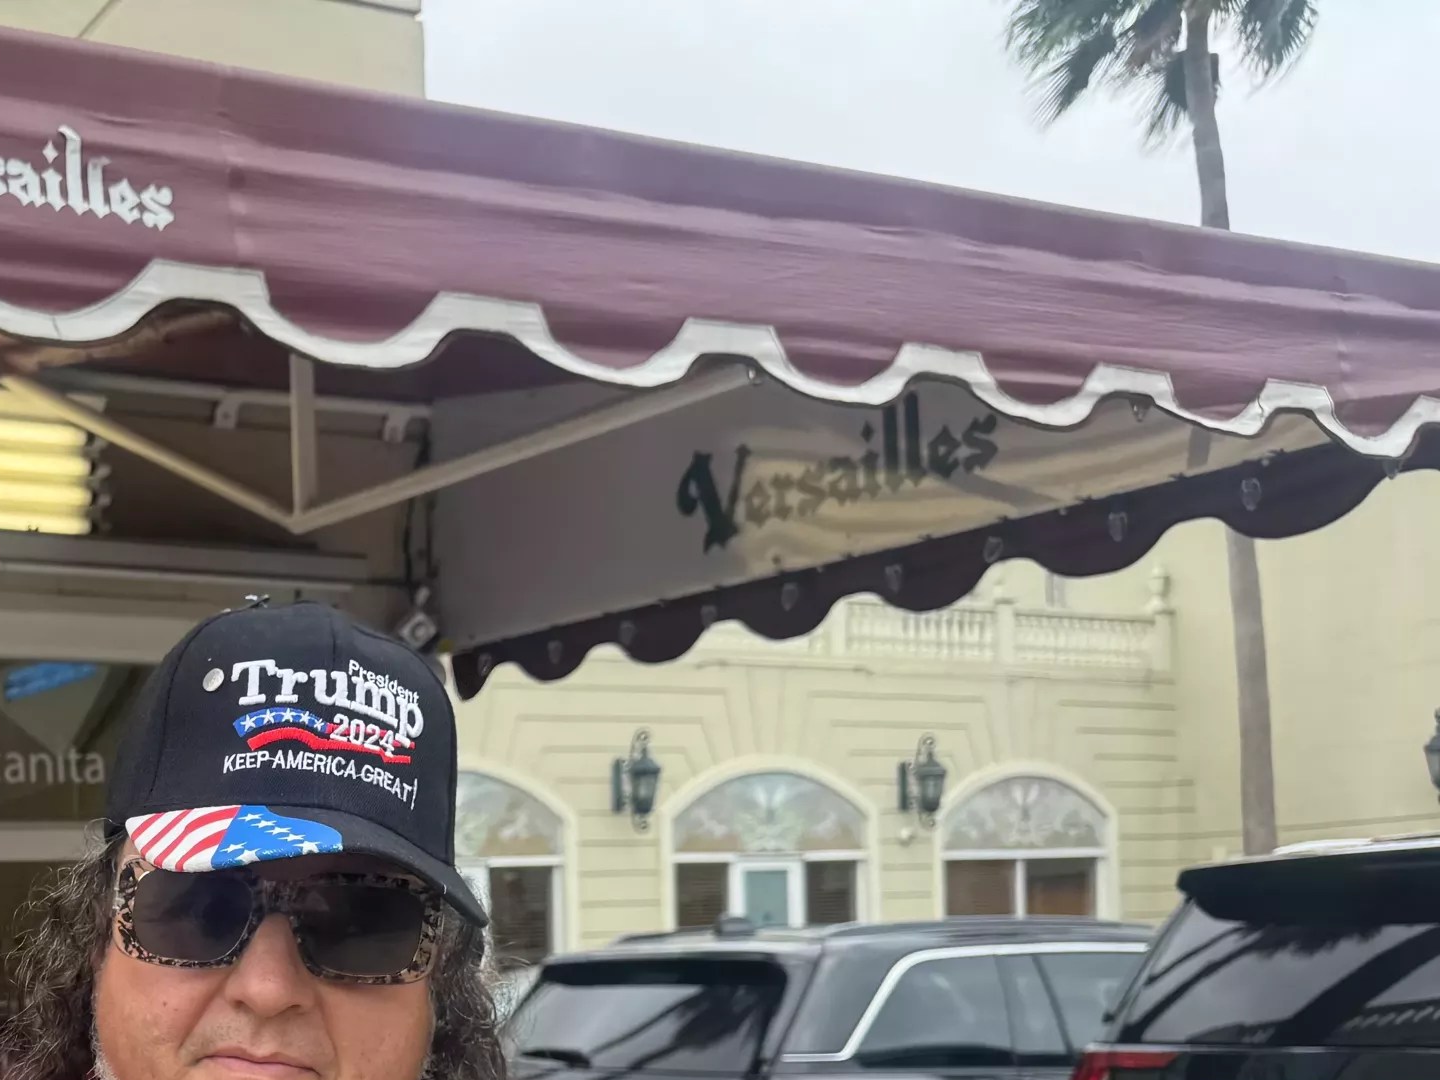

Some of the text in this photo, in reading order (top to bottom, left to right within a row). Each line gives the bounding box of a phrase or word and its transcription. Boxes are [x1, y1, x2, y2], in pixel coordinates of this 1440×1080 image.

[676, 389, 999, 554] Versailles
[230, 658, 425, 749] Trump
[348, 659, 420, 706] President
[329, 712, 395, 758] 2024
[222, 750, 270, 775] KEEP
[272, 749, 357, 780] AMERICA
